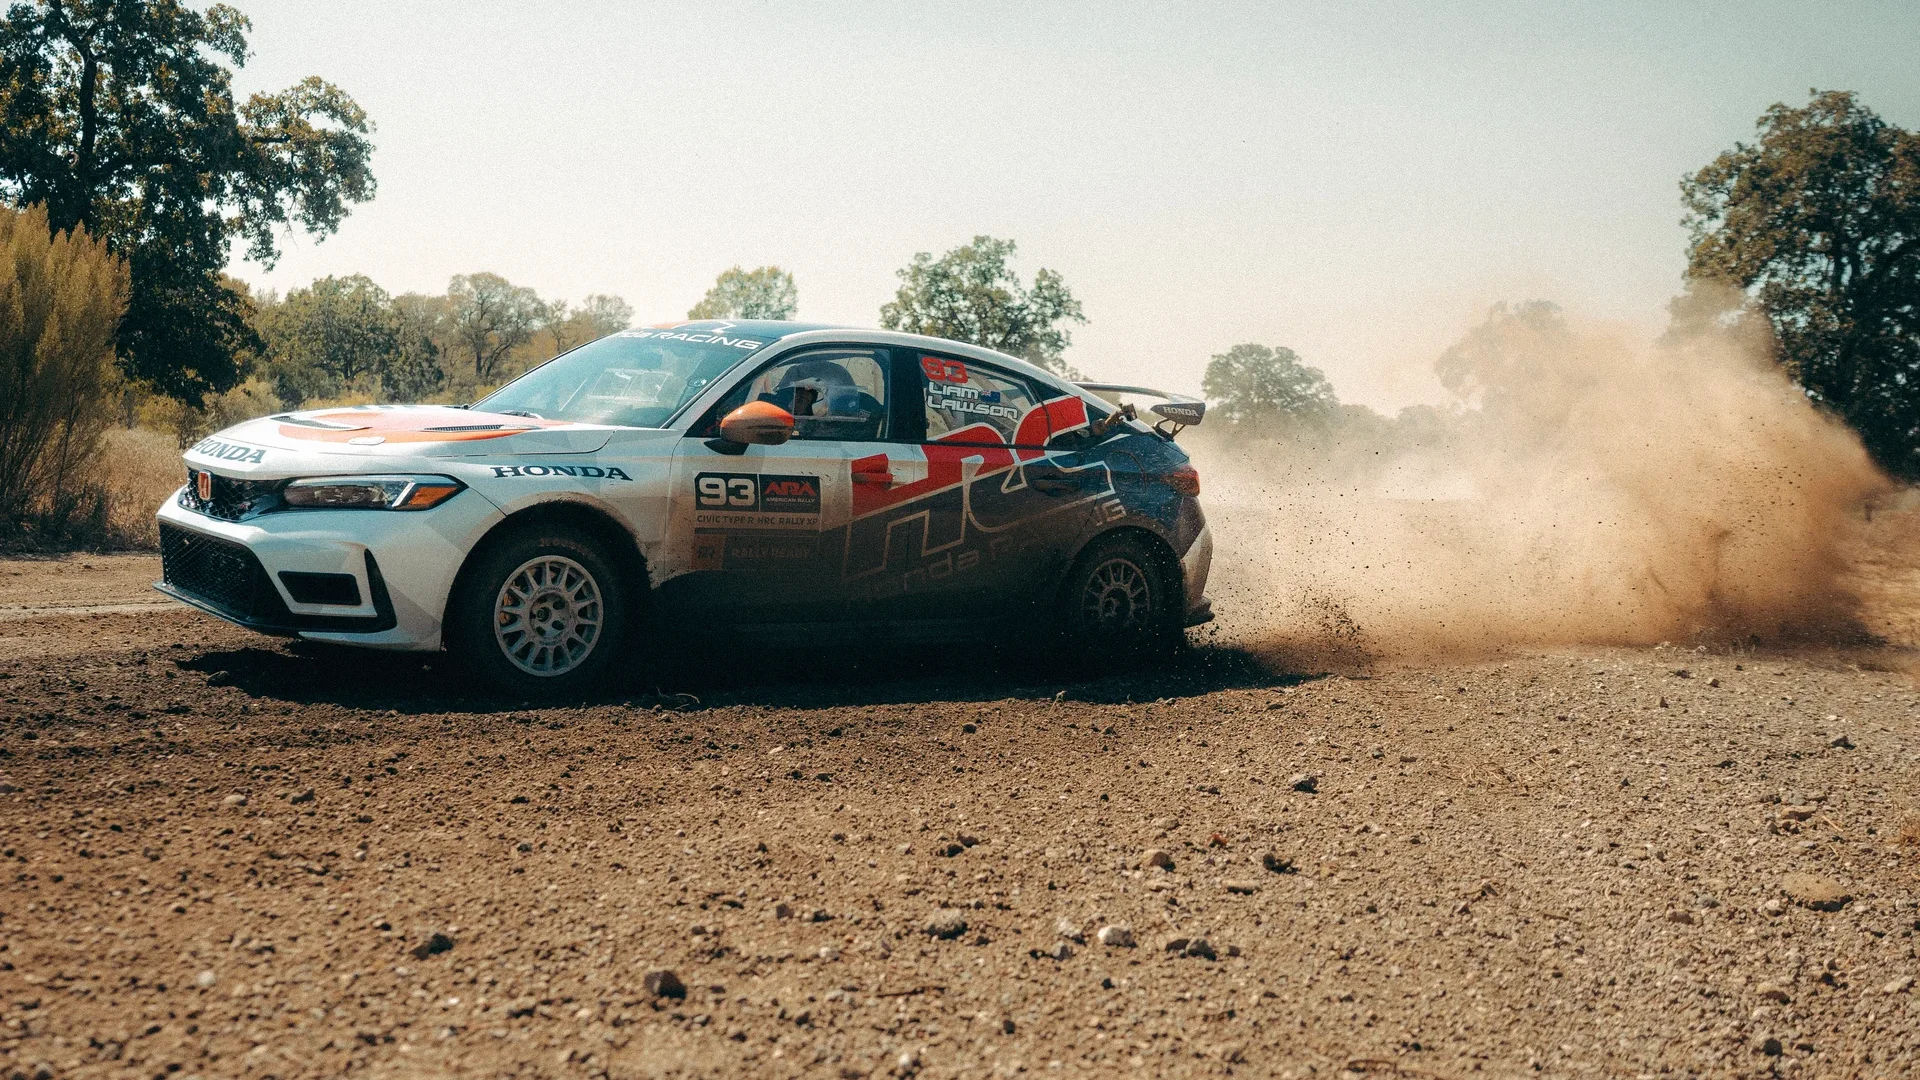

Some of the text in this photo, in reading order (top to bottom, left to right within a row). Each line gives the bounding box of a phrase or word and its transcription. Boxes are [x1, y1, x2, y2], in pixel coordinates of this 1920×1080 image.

[651, 332, 763, 349] RACING
[920, 356, 969, 384] 93
[928, 380, 980, 400] LIAM
[926, 395, 1019, 420] LAWSON
[1162, 405, 1200, 417] HONDA
[192, 438, 267, 463] HONDA
[490, 465, 634, 481] HONDA
[698, 477, 755, 506] 93
[764, 481, 817, 496] ARA
[696, 514, 819, 526] CIVIC TYPE R HRC RALLY XP
